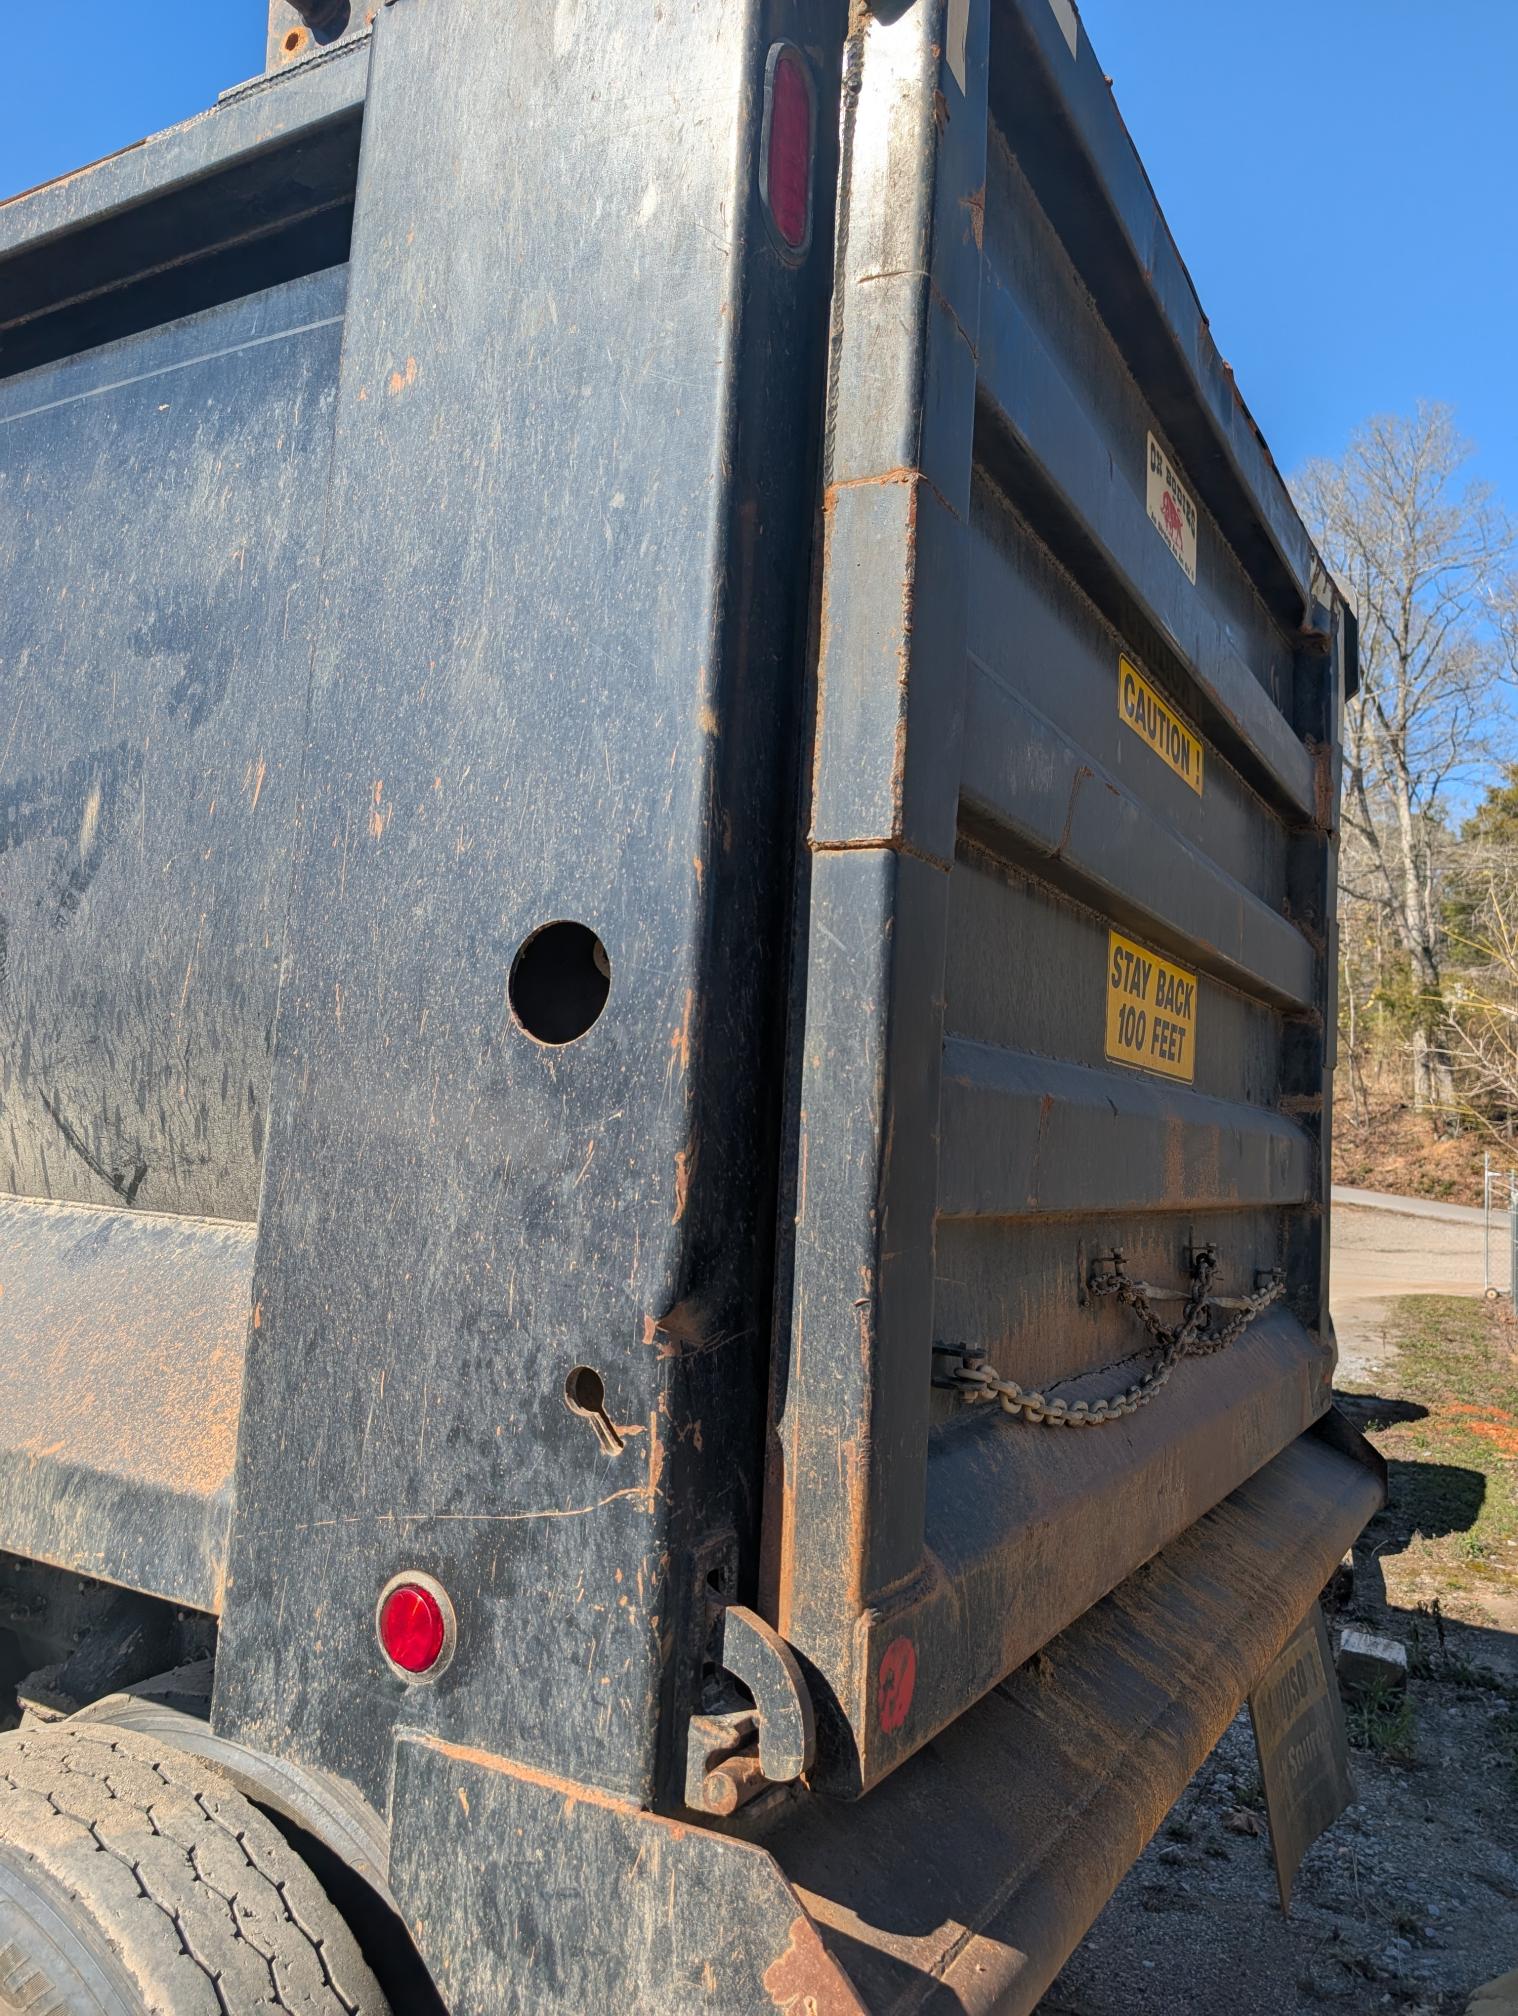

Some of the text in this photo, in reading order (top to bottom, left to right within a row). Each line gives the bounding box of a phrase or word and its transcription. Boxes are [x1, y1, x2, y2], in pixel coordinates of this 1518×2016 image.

[1150, 441, 1162, 477] OX
[1166, 463, 1196, 539] BODIES
[1124, 673, 1190, 775] CAUTION
[1111, 945, 1194, 1020] STAY BACK
[1118, 1003, 1186, 1063] 100 FEET
